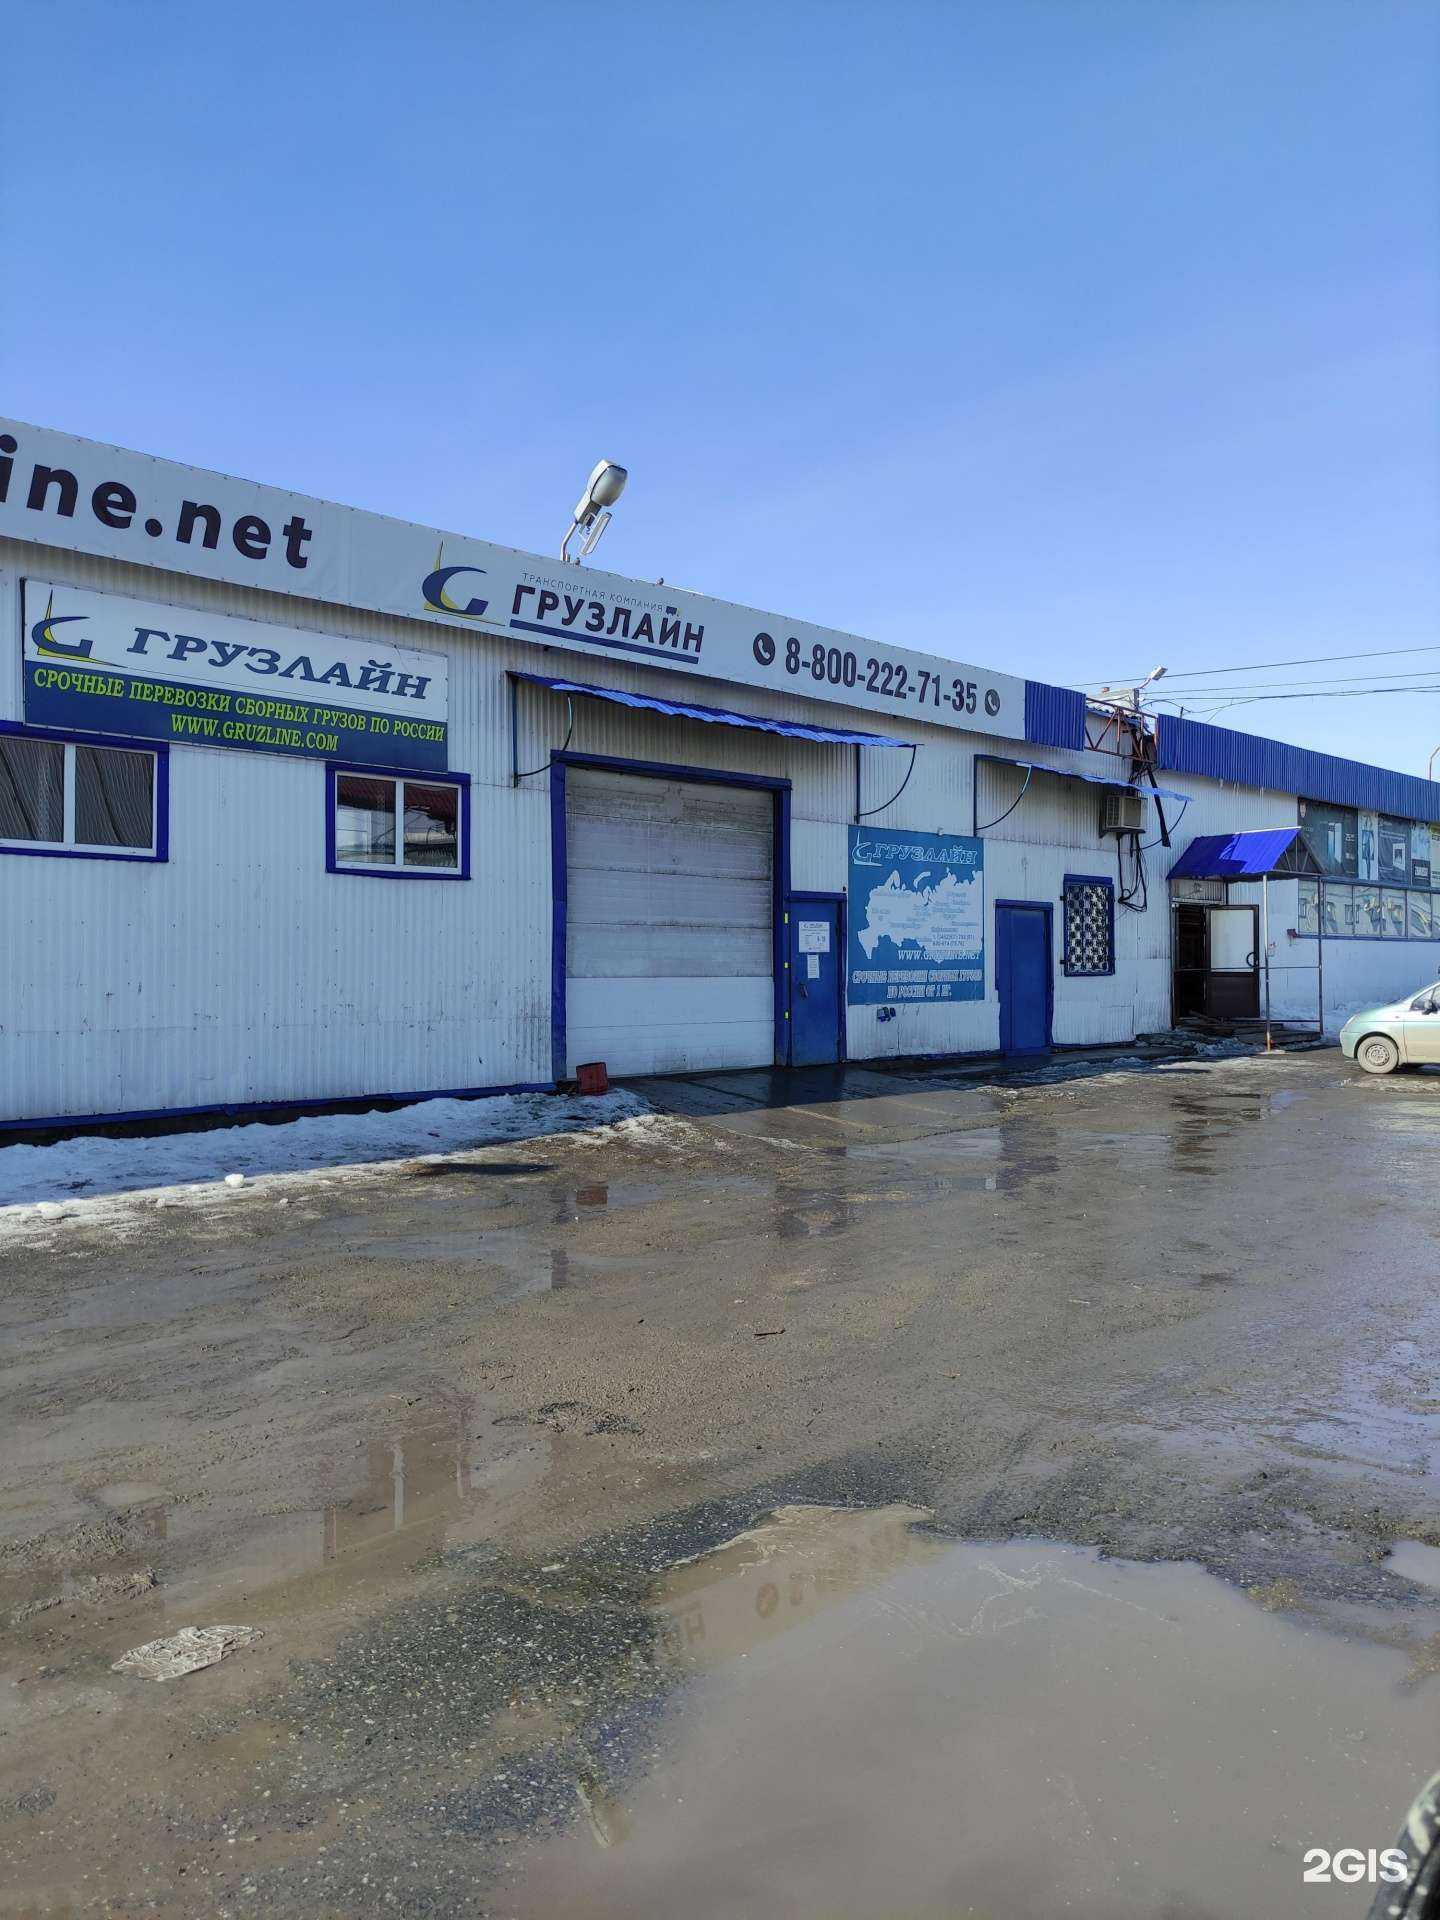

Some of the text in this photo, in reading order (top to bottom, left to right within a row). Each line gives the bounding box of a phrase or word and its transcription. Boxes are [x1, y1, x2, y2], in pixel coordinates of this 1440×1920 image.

[0, 434, 313, 569] ine.net
[522, 572, 663, 613] ТРАНСПОРТНАЯ КОМПАНИЯ
[126, 627, 432, 700] ГРУЗЛАЙН
[785, 637, 978, 715] 8-800-222-71-35
[34, 668, 446, 742] СРОЧНЫЕ ПЕРЕВОЗКИ СБОРНЫХ ГРУЗОВ ПО РОССИИ
[171, 712, 340, 752] WWW.GRUZLINE.COM
[872, 842, 978, 865] ГРУЗЛАЙН
